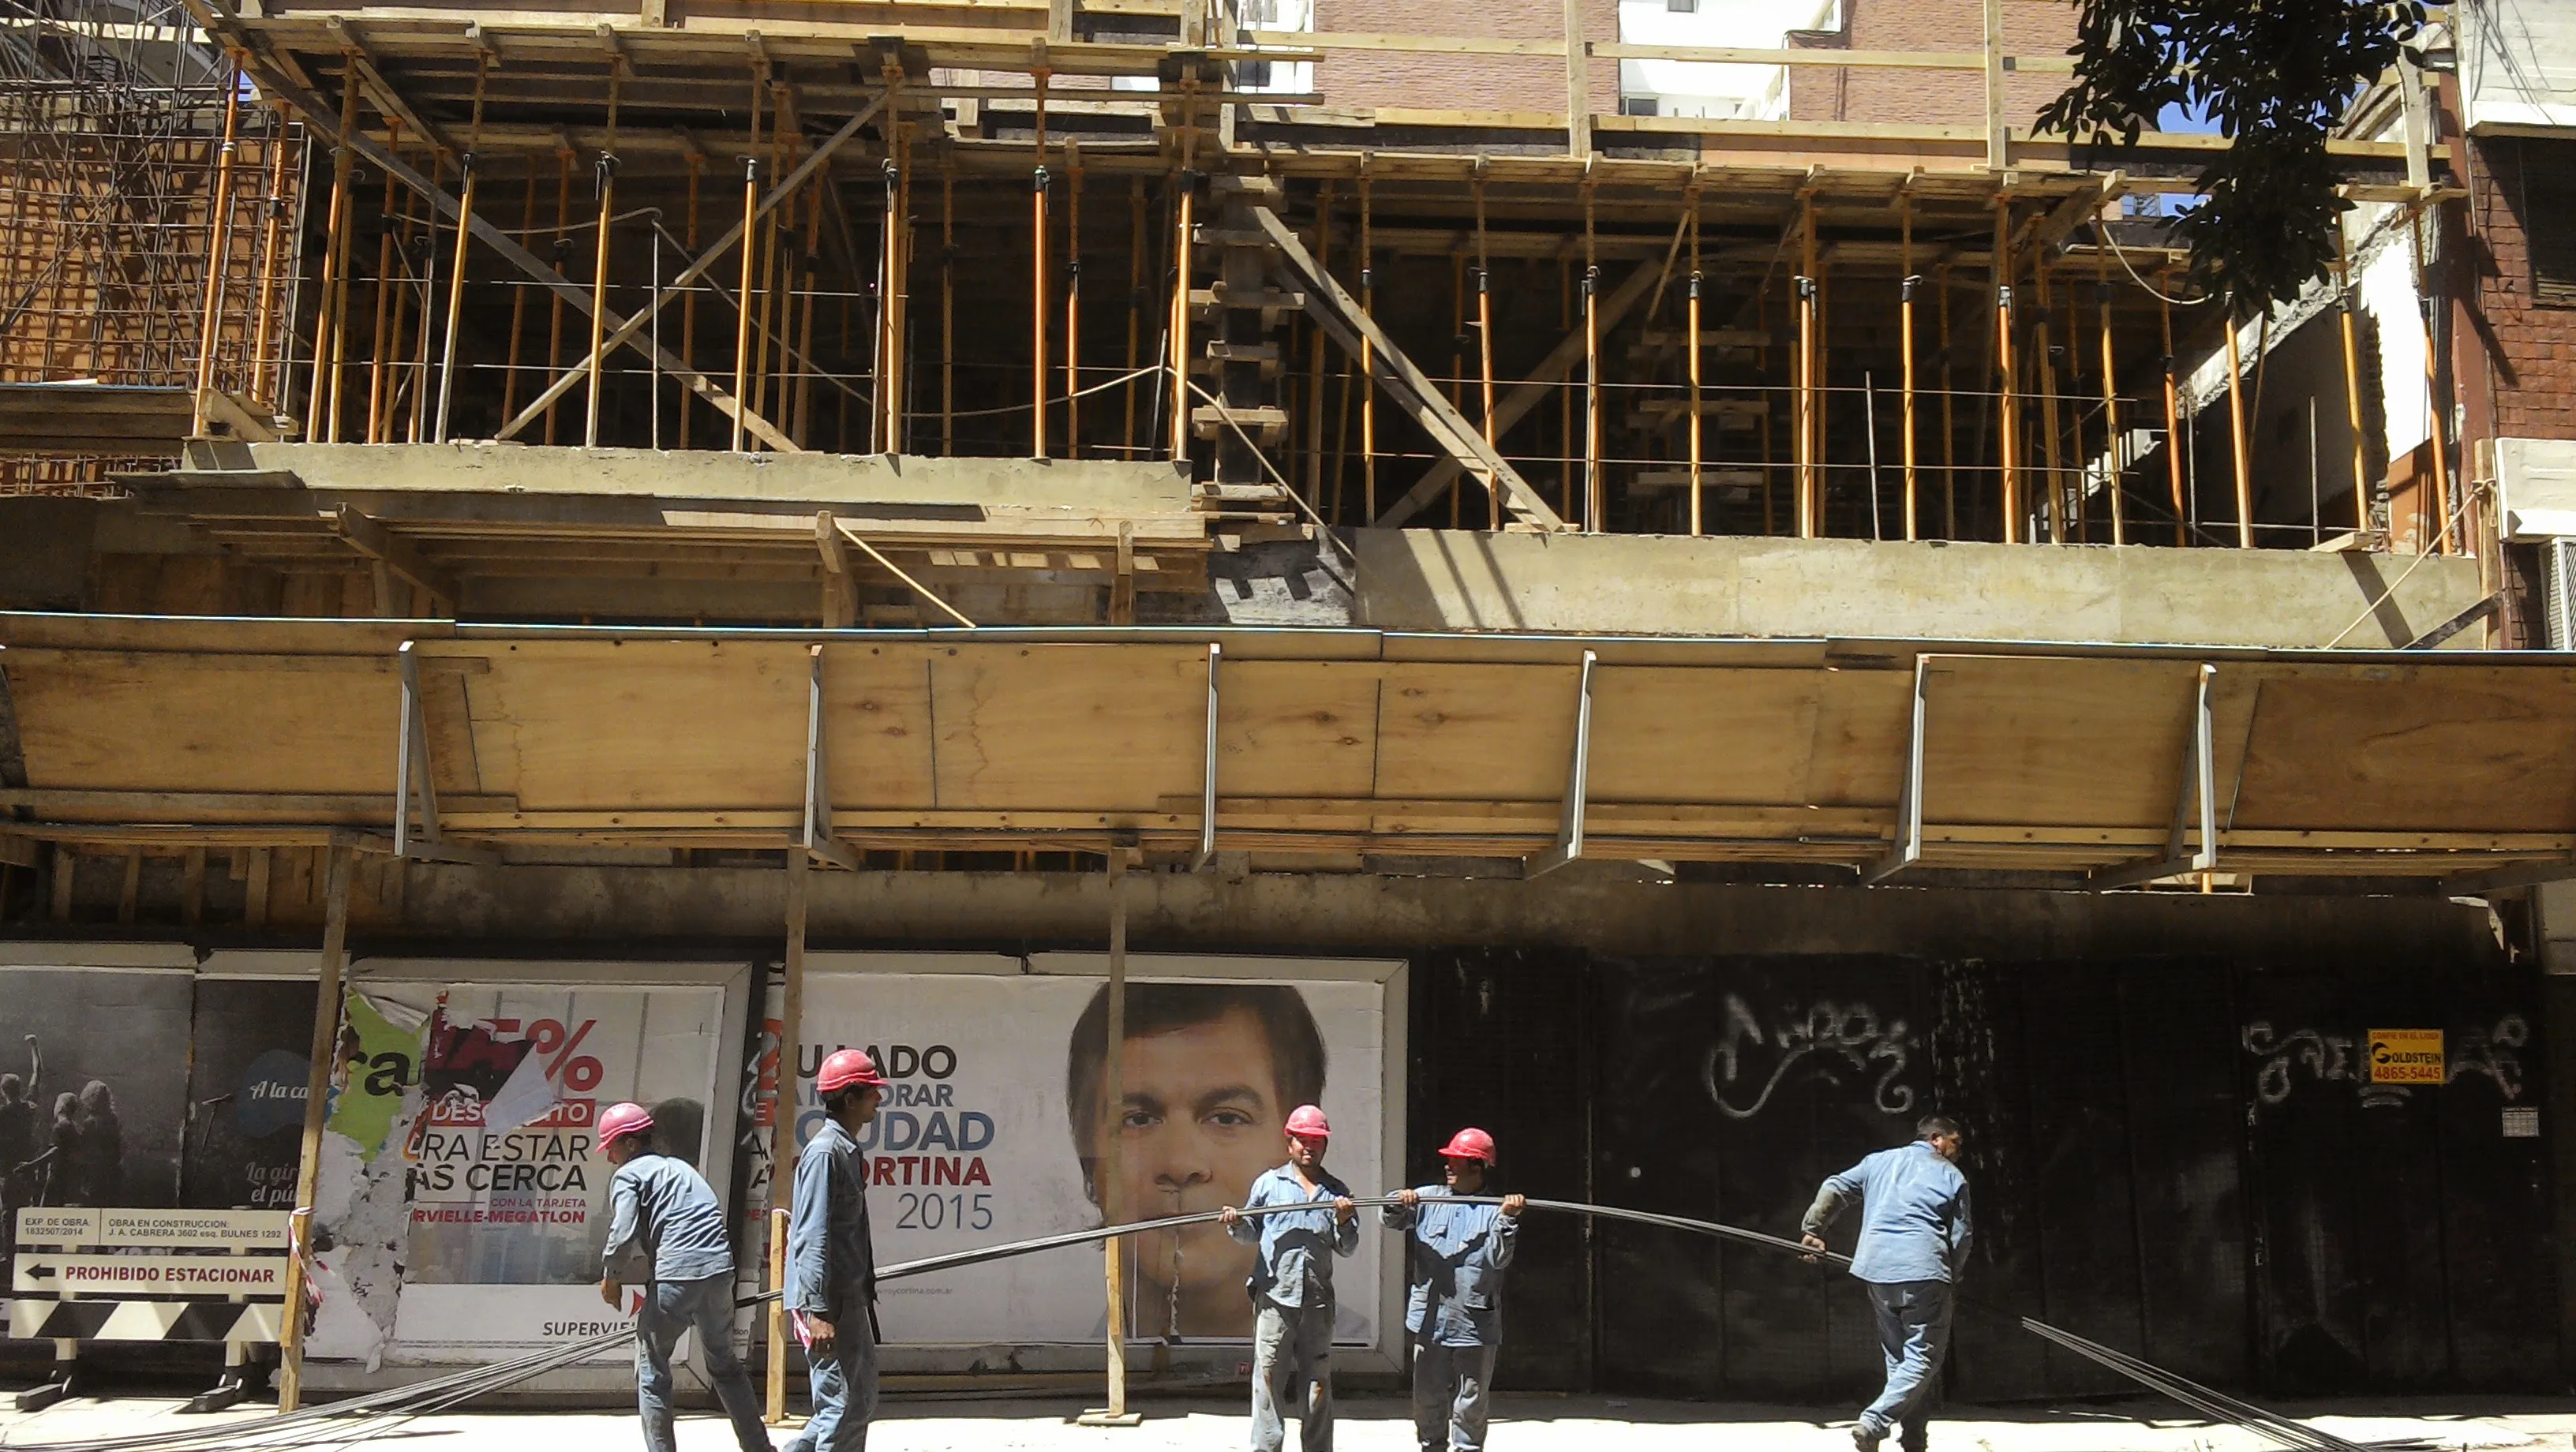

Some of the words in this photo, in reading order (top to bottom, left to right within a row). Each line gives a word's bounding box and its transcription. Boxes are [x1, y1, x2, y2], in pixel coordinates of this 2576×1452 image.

[2372, 1042, 2441, 1064] GOLDSTEIN
[2374, 1066, 2441, 1080] 4865-5445
[269, 1082, 287, 1098] la
[795, 1110, 994, 1151] CUDAD
[481, 1133, 590, 1162] ESTAR
[245, 1162, 267, 1184] La
[466, 1163, 587, 1191] CERCA
[251, 1184, 267, 1203] el
[490, 1198, 516, 1207] CON
[519, 1198, 533, 1207] LA
[537, 1198, 586, 1208] TARJETA
[896, 1192, 994, 1230] 2015
[47, 1218, 60, 1226] DE
[108, 1218, 136, 1228] OBRA
[137, 1219, 150, 1228] EN
[25, 1227, 84, 1236] 1832507/2014
[129, 1229, 175, 1237] CABRERA
[220, 1229, 259, 1238] BULNES
[261, 1229, 282, 1239] 1292
[66, 1266, 159, 1282] PROHIBIDO
[165, 1267, 275, 1283] ESTACIONAR
[542, 1322, 636, 1336] SUPERVIE
